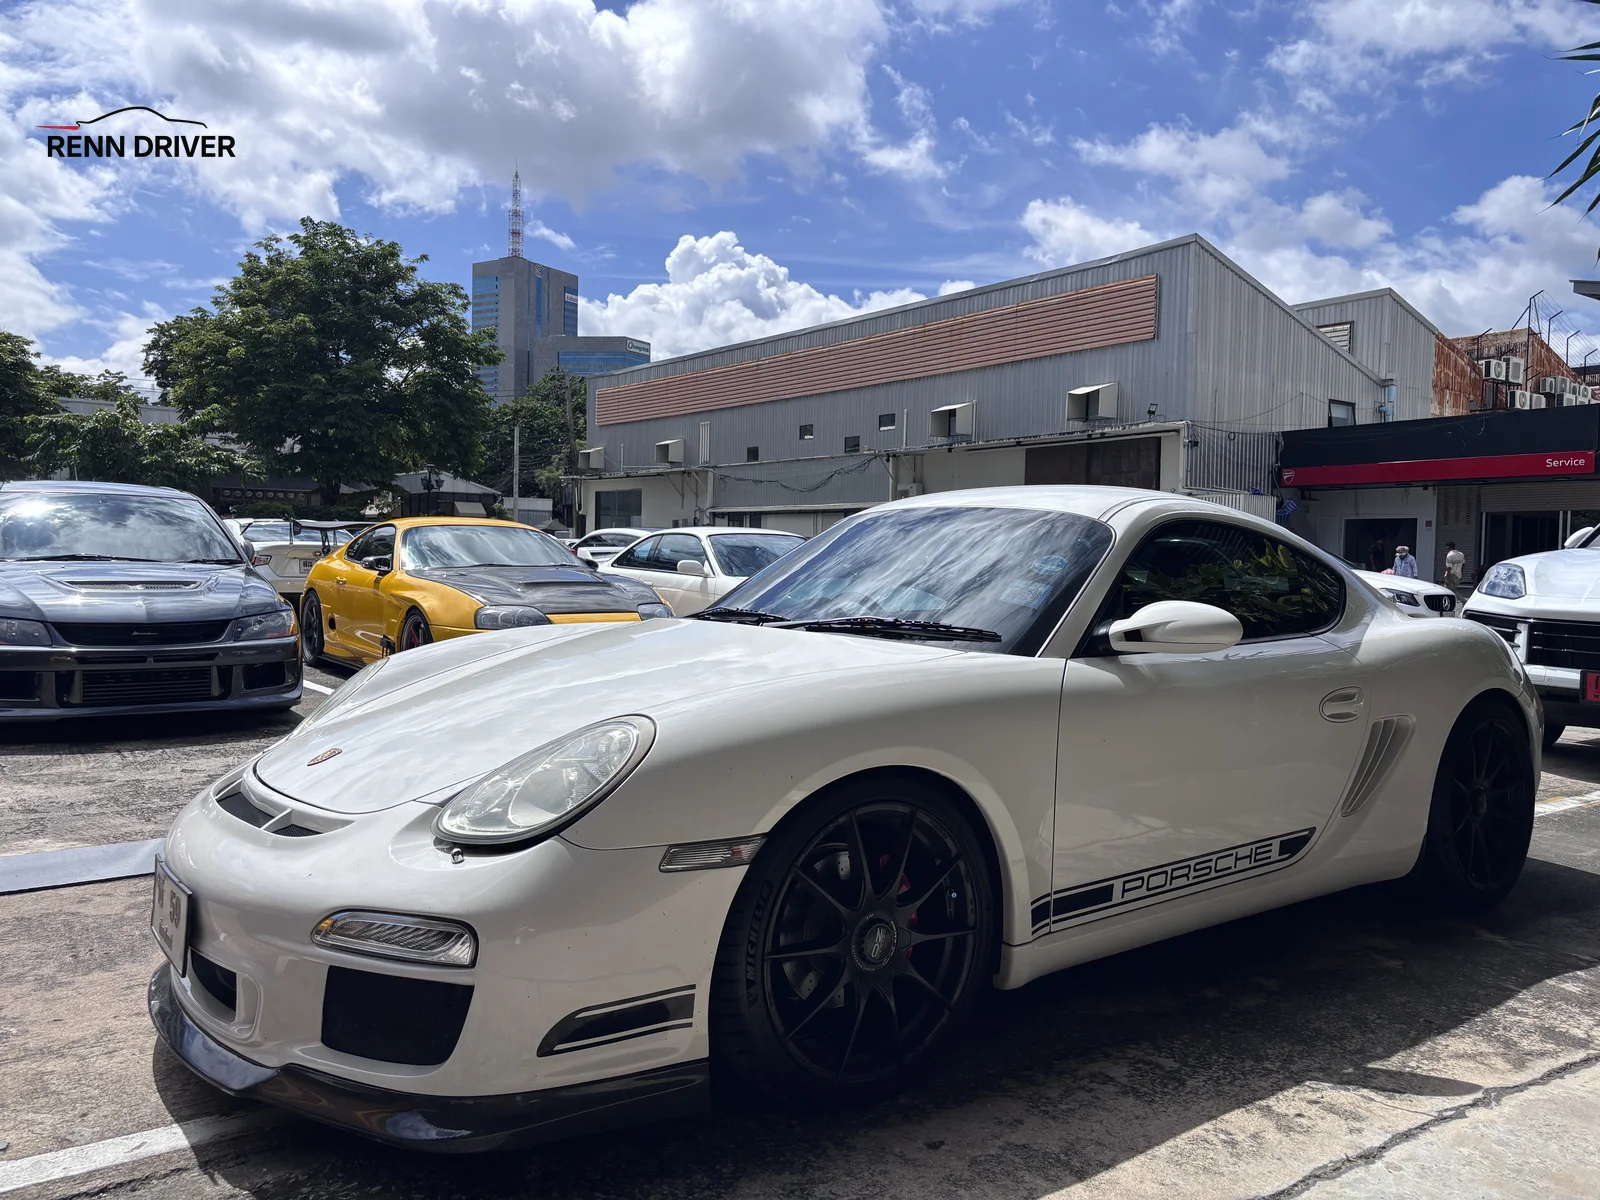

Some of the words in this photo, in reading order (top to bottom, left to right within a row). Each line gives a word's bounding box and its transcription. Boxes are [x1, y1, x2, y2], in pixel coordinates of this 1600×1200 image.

[1546, 457, 1585, 468] Service
[1121, 843, 1273, 899] PORSCHE
[169, 889, 182, 929] 59
